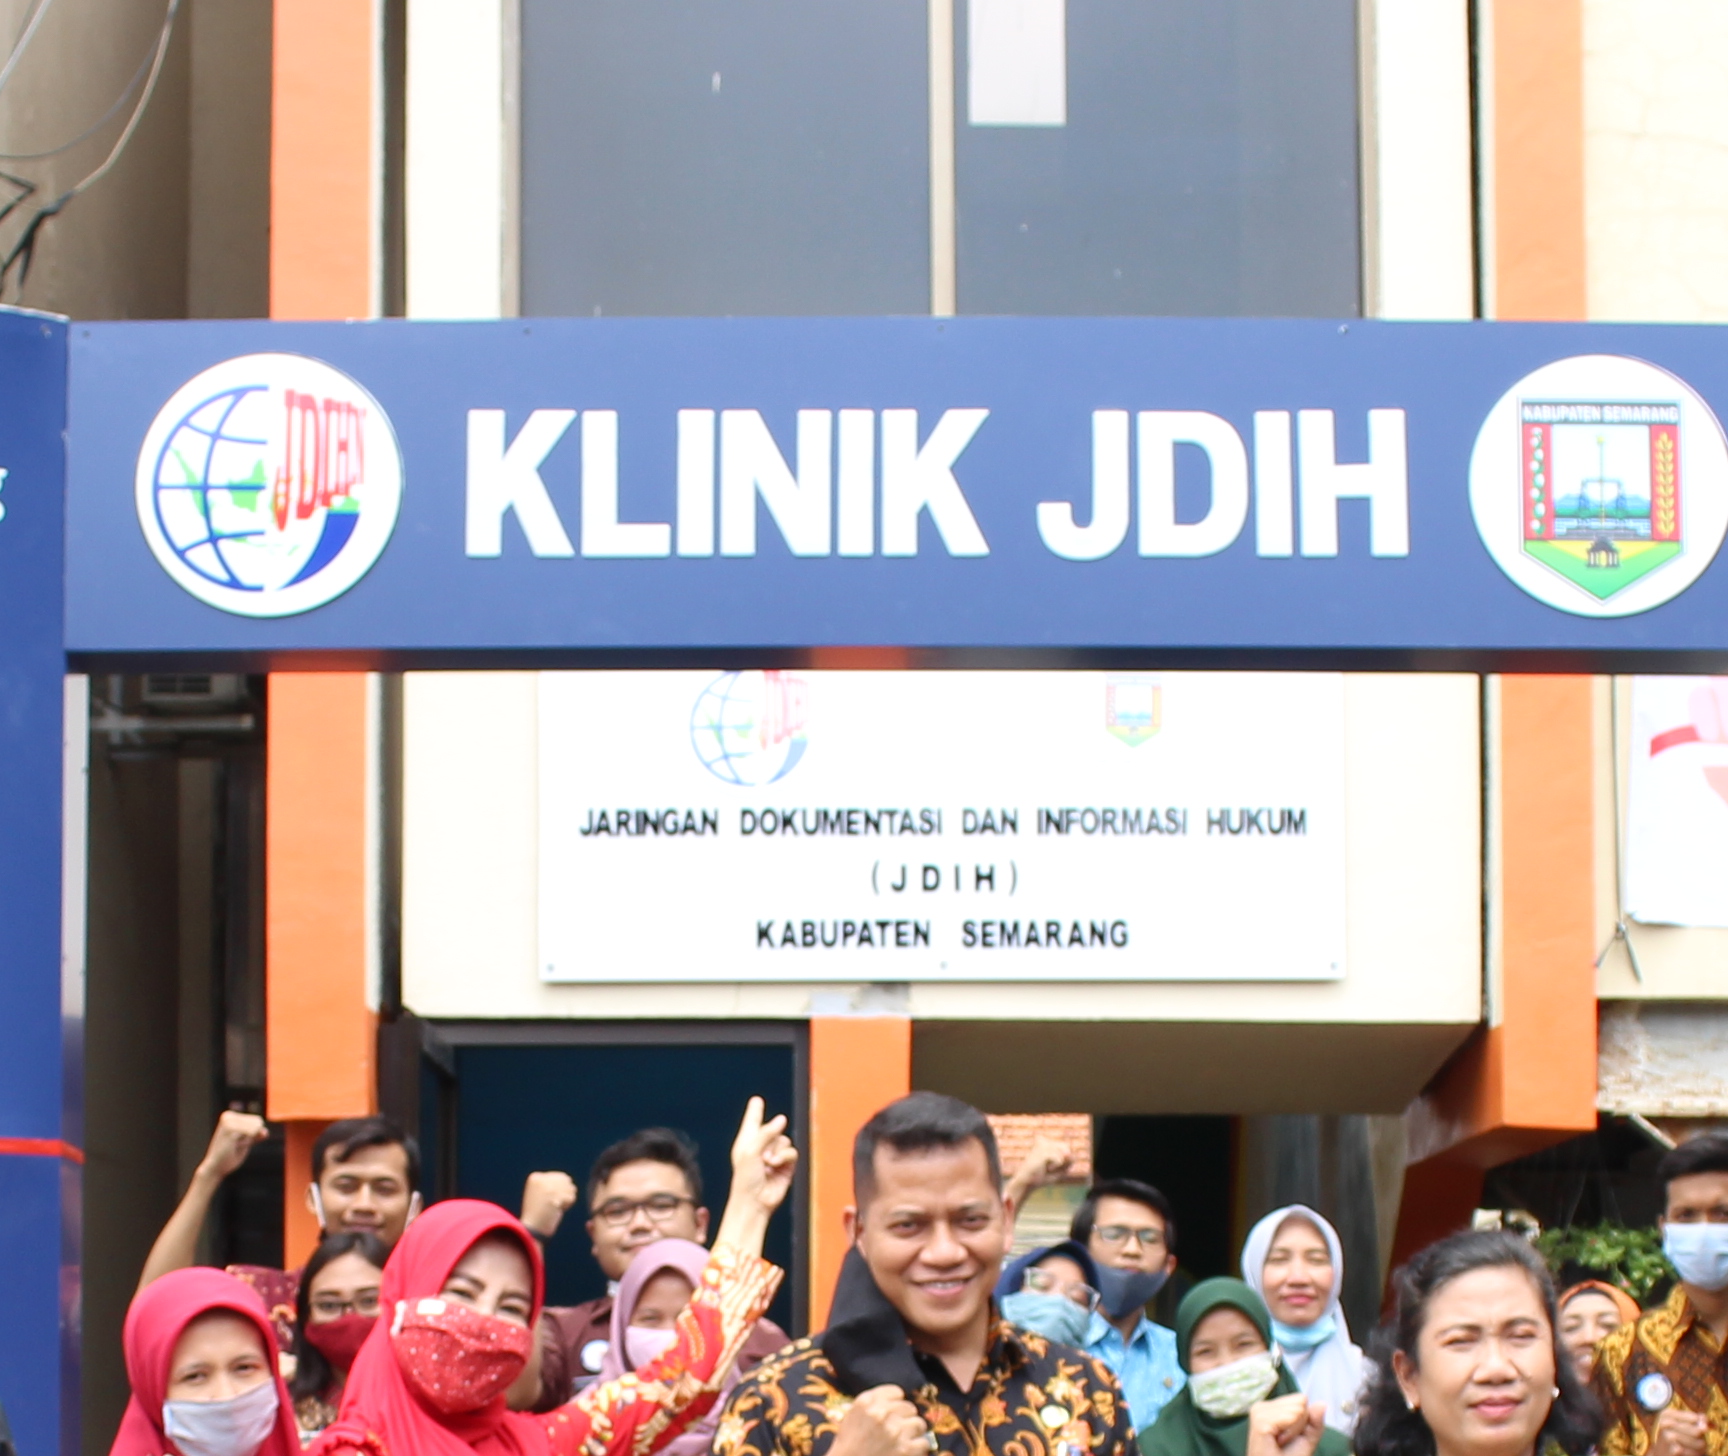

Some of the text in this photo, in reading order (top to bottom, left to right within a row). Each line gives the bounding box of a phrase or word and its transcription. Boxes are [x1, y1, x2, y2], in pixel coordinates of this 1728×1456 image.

[1523, 404, 1679, 423] KABUPATEN SEMARANG
[466, 409, 1408, 558] KLINIK JDIH
[580, 807, 1306, 836] JARINGAN DOKUMENTASI DAN INFORMASI HUKUM
[757, 920, 1128, 948] KABUPATEN SEMARANG
